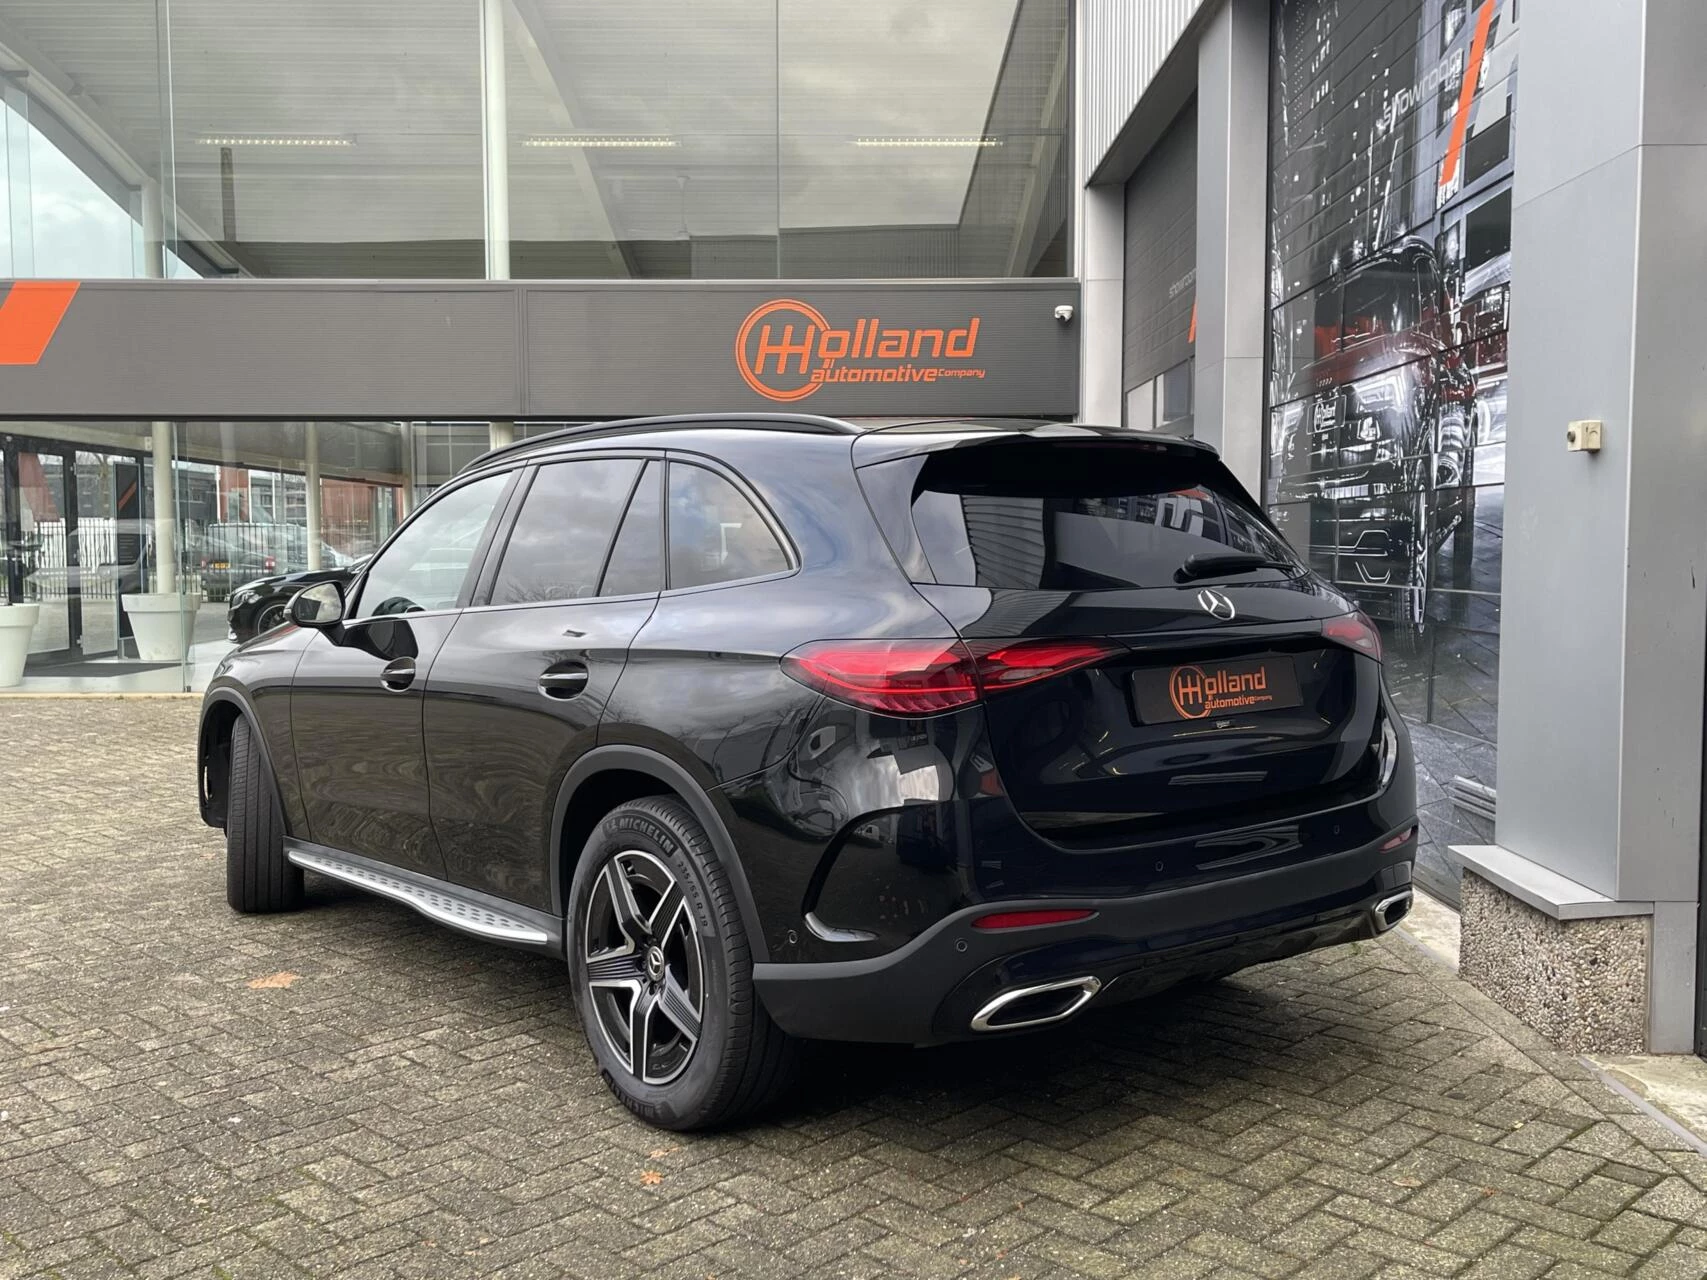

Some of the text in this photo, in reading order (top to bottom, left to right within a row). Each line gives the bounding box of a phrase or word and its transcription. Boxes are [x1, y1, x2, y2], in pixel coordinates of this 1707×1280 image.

[755, 318, 980, 374] Holland
[810, 363, 986, 382] automotive Company
[1178, 666, 1267, 705] Holland
[1204, 694, 1255, 710] automotive
[619, 817, 675, 855] MICHELIN
